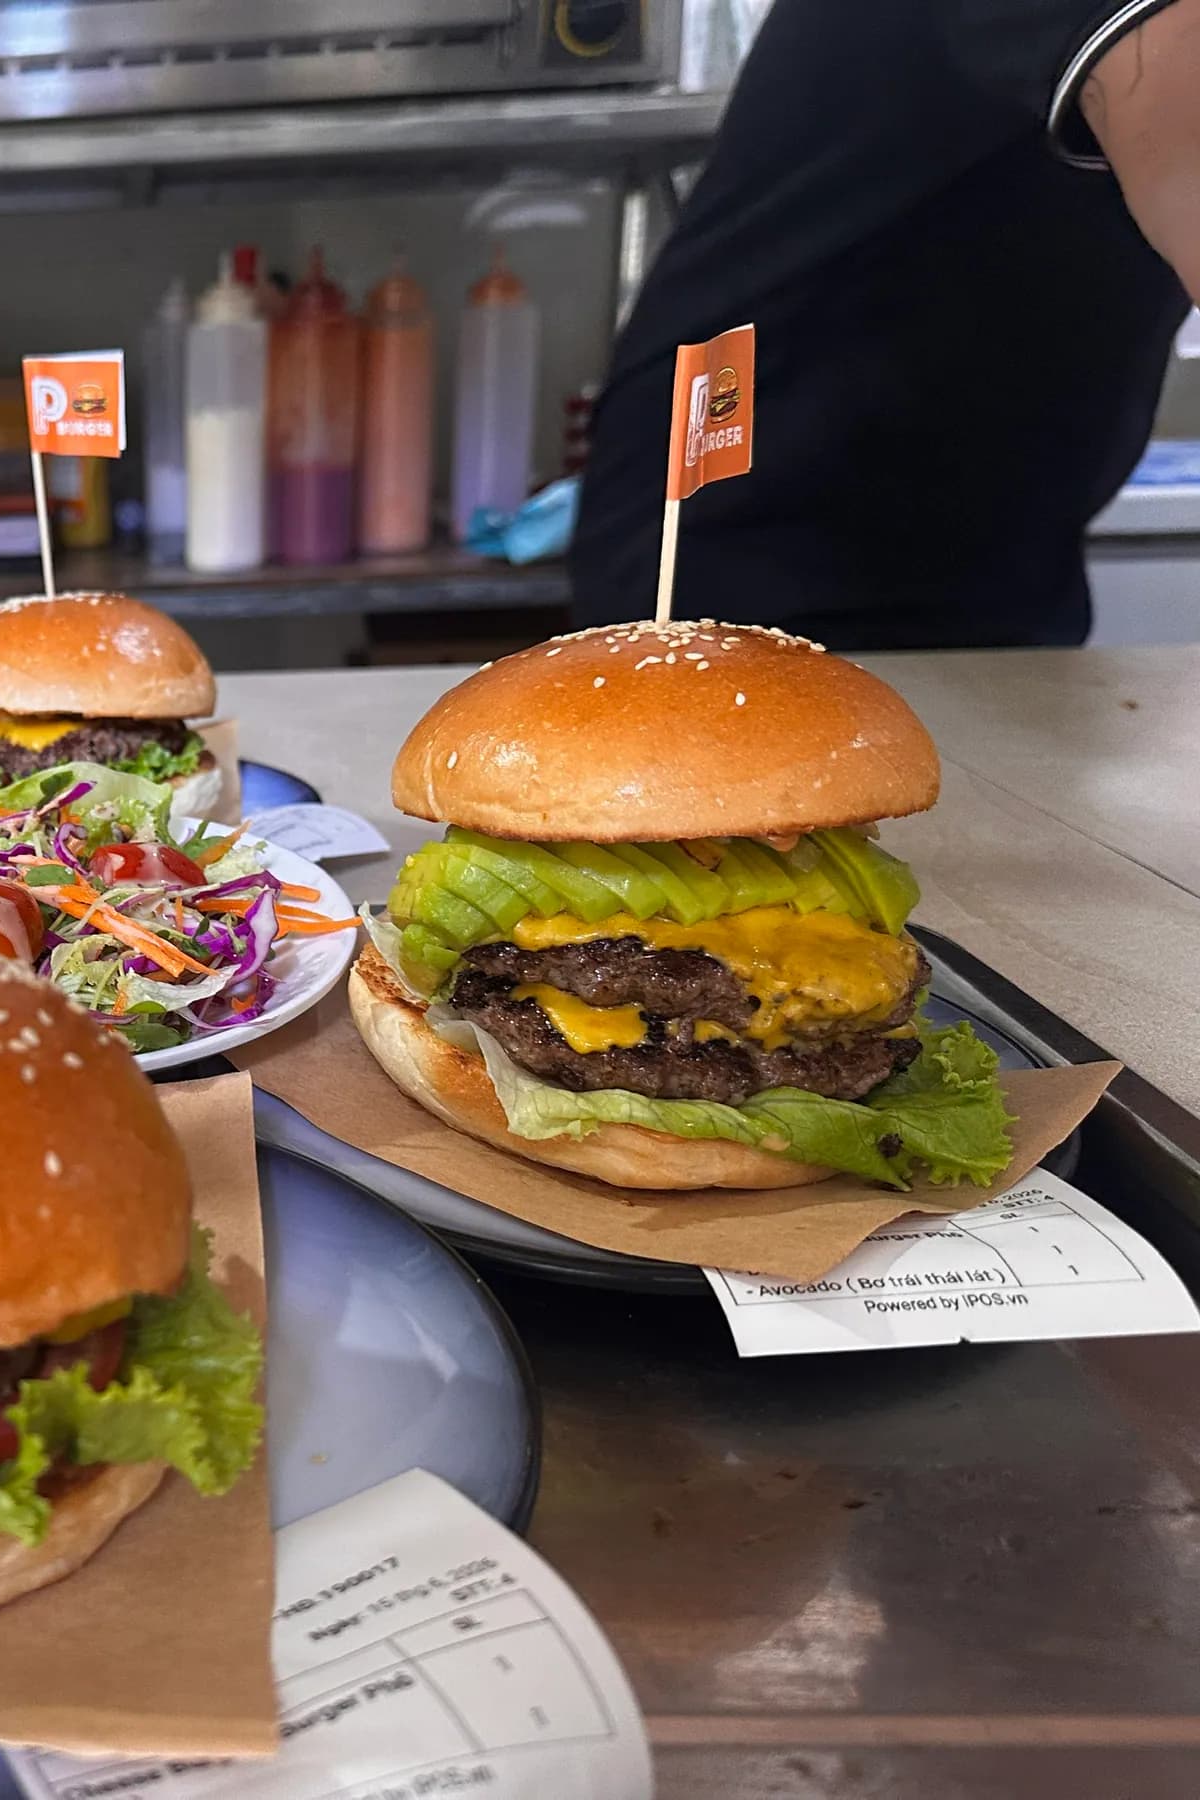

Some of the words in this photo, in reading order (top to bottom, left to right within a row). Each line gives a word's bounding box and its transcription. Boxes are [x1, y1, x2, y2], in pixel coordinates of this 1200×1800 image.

[31, 377, 68, 435] P
[759, 1280, 843, 1297] Avocado
[845, 1276, 859, 1294] (
[888, 1274, 923, 1288] trái
[925, 1271, 964, 1284] thái
[964, 1269, 995, 1282] lát
[992, 1267, 1006, 1285] )
[863, 1298, 939, 1314] Powered
[940, 1297, 960, 1311] by
